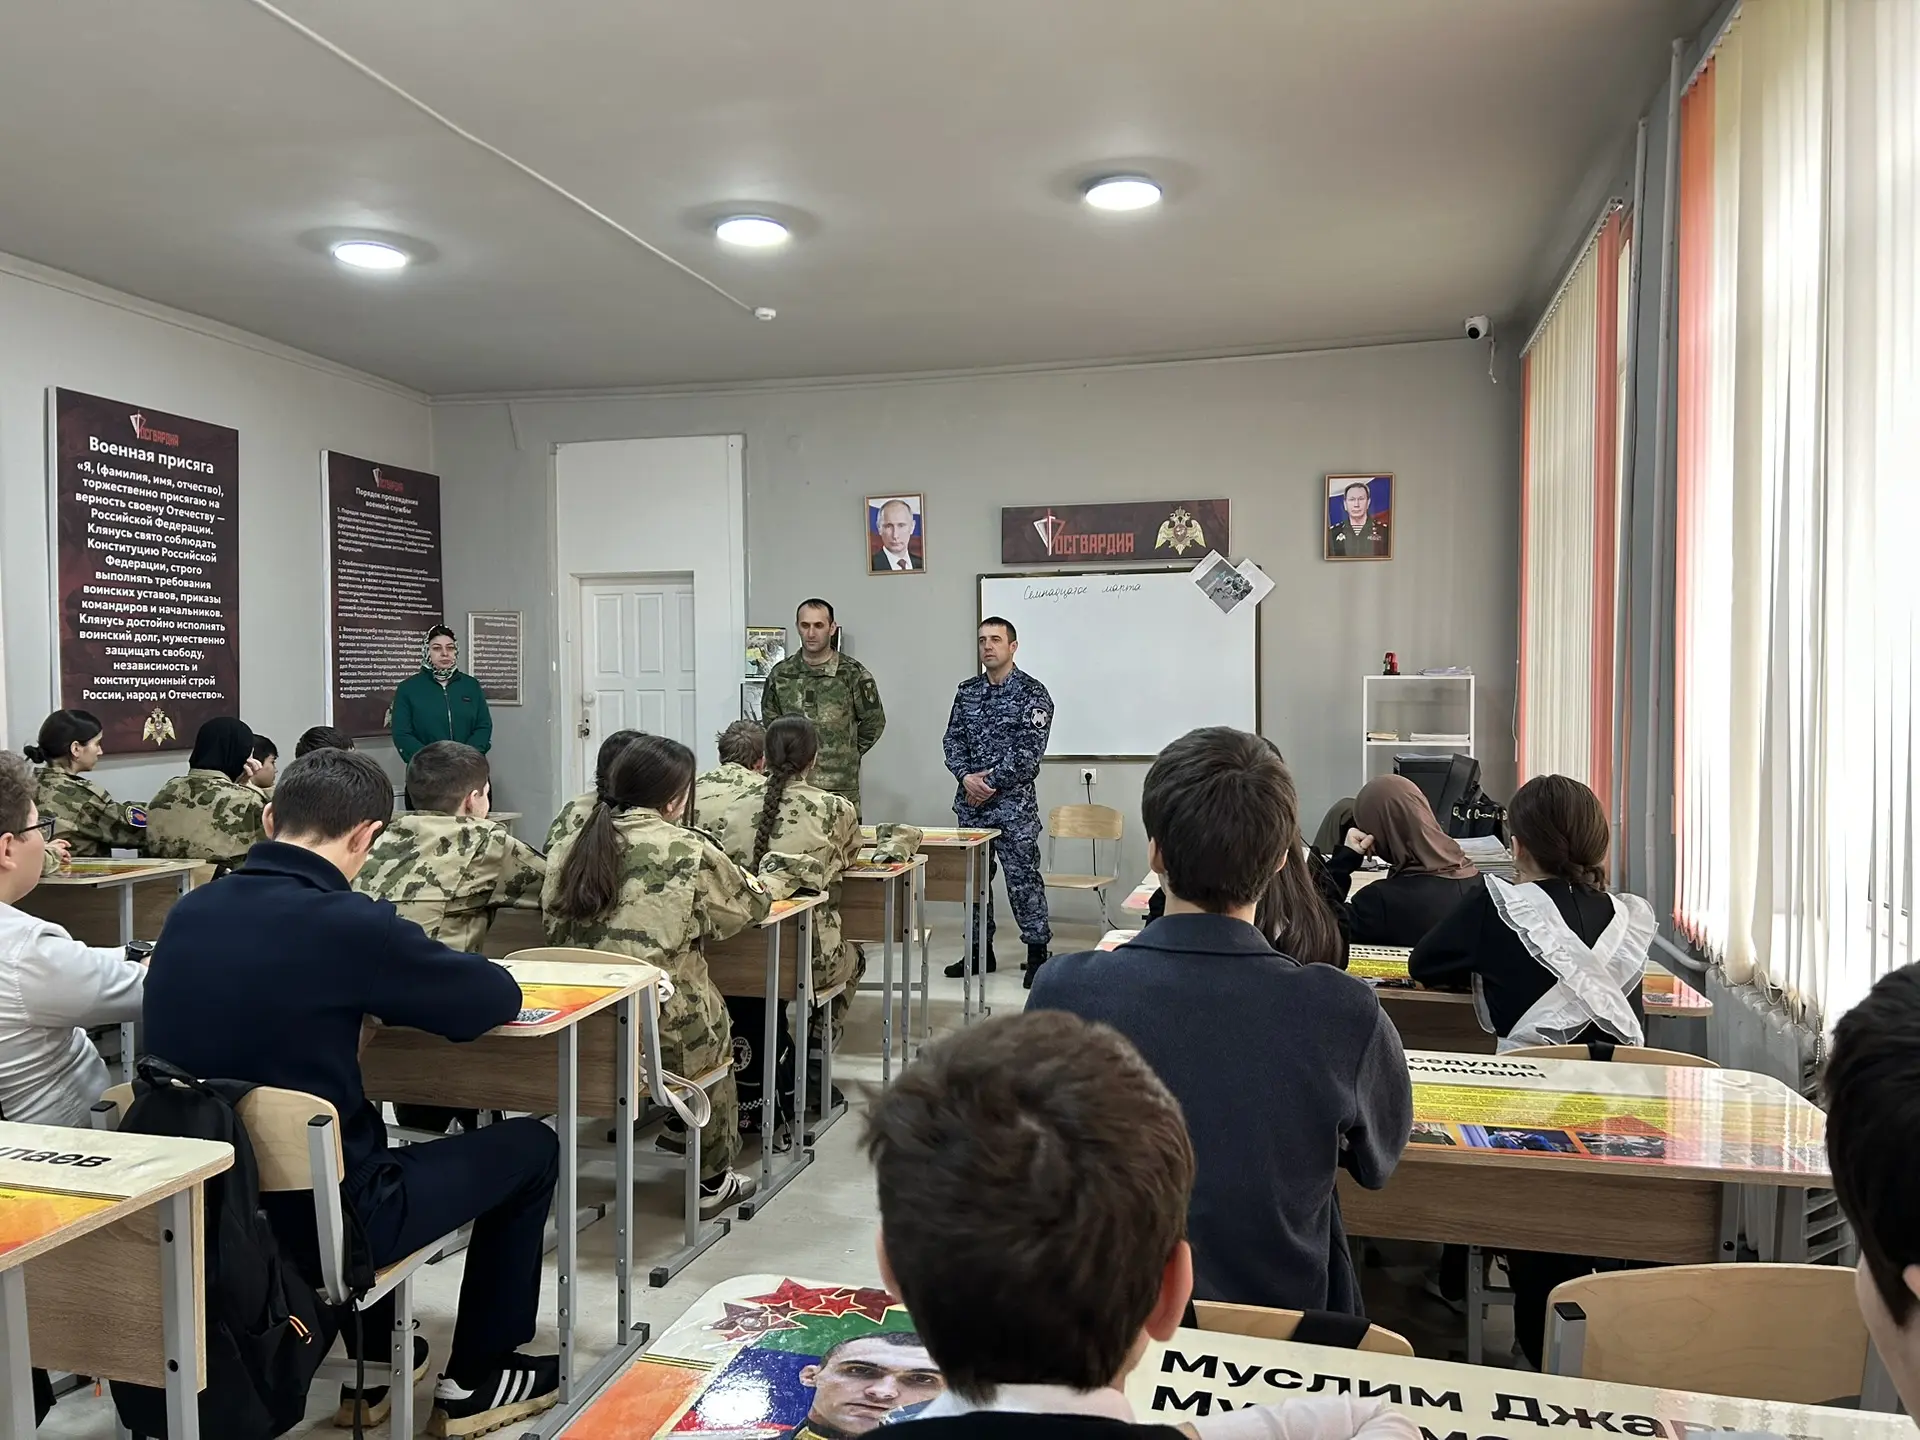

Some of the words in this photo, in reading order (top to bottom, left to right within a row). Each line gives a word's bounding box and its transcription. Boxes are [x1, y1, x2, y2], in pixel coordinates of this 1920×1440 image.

[89, 436, 155, 463] Военная
[158, 453, 214, 474] присяга
[96, 462, 151, 484] (фамилия,
[153, 477, 174, 488] имя,
[177, 480, 224, 497] отчество),
[82, 477, 158, 498] торжественно
[160, 491, 206, 507] присягаю
[209, 499, 220, 509] на
[75, 492, 126, 508] верность
[128, 500, 164, 515] своему
[166, 506, 215, 523] Отечеству
[390, 504, 411, 515] службы
[91, 508, 153, 527] Российской
[155, 517, 214, 536] Федерации.
[87, 523, 132, 539] Клянусь
[135, 530, 162, 542] свято
[164, 533, 217, 550] соблюдать
[87, 538, 159, 557] Конституцию
[161, 549, 217, 563] Российской
[105, 554, 169, 573] Федерации,
[171, 564, 203, 576] строго
[95, 570, 153, 585] выполнять
[155, 577, 212, 590] требования
[83, 585, 135, 597] воинских
[137, 590, 179, 601] уставов,
[181, 593, 221, 604] приказы
[1102, 583, 1141, 599] марта
[82, 600, 148, 613] командиров
[150, 605, 156, 613] и
[159, 606, 223, 618] начальников.
[79, 614, 124, 629] Клянусь
[126, 618, 175, 629] достойно
[177, 621, 225, 632] исполнять
[79, 630, 132, 641] воинский
[134, 634, 160, 644] долг,
[162, 635, 225, 645] мужественно
[105, 646, 160, 657] защищать
[162, 648, 205, 660] свободу,
[113, 661, 189, 672] независимость
[192, 663, 198, 671] и
[94, 674, 187, 686] конституционный
[189, 675, 216, 687] строй
[82, 690, 125, 702] России,
[126, 692, 158, 701] народ
[168, 690, 224, 700] Отечество».
[1407, 1065, 1548, 1079] минович
[1160, 1349, 1465, 1413] Муслим
